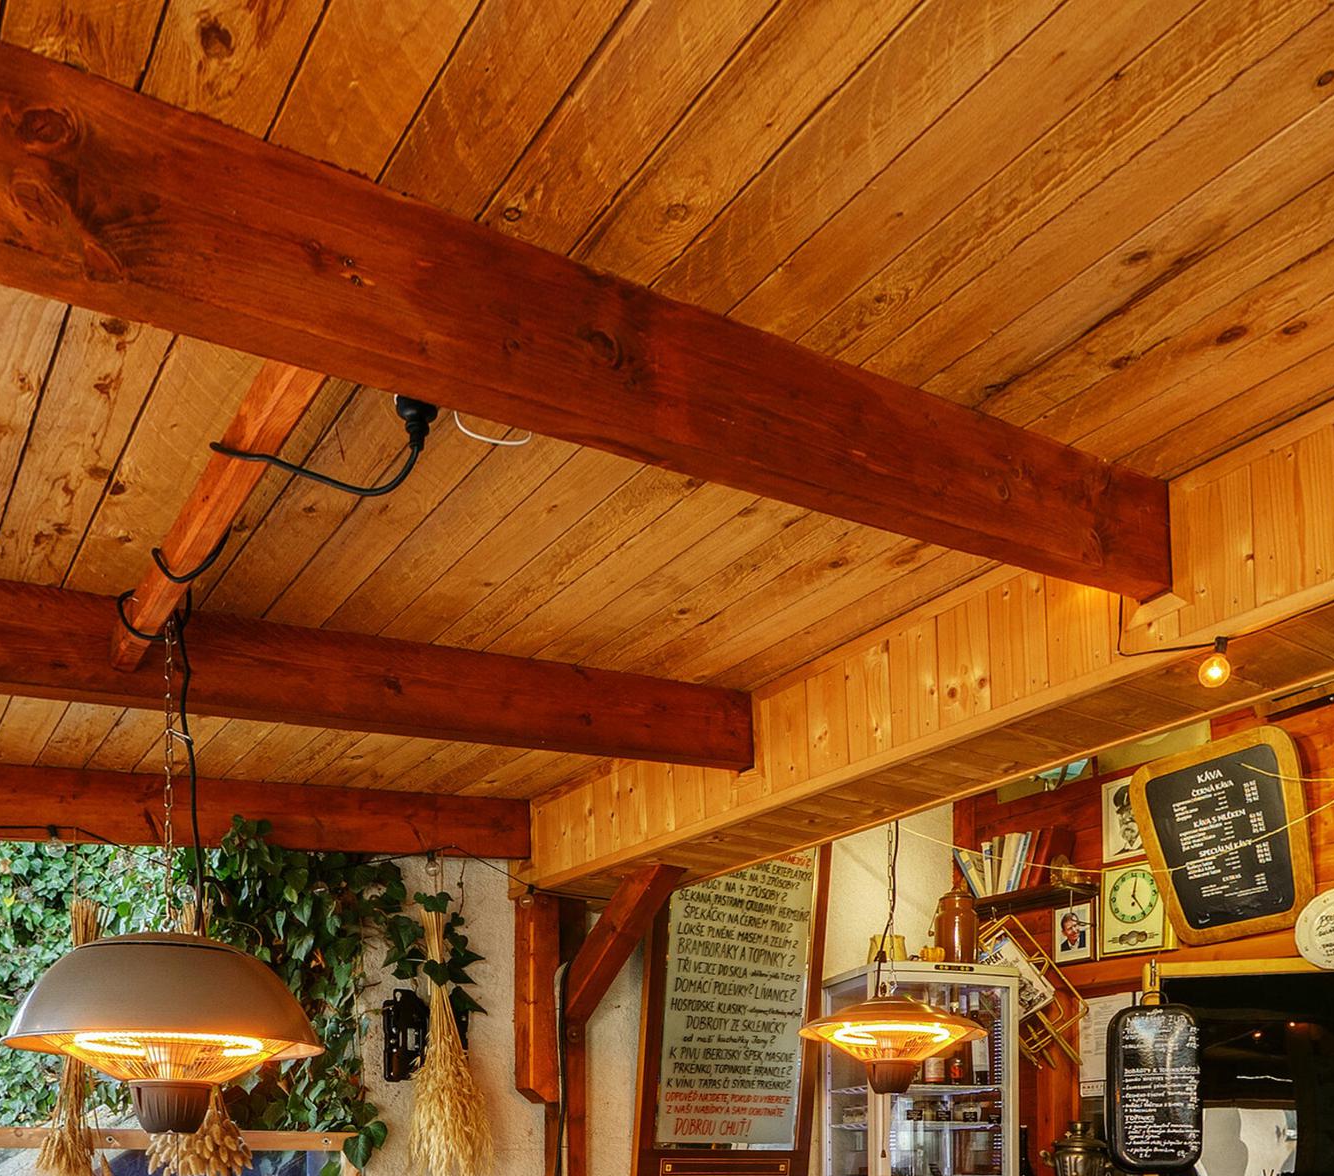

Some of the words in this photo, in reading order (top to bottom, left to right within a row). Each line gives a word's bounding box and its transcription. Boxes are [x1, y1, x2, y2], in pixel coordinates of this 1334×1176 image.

[1196, 769, 1223, 784] KÁVA
[749, 873, 758, 883] NA
[725, 882, 737, 893] NA
[739, 883, 744, 894] 4
[683, 903, 727, 922] ŠPEKÁČKY
[728, 913, 739, 924] NA
[677, 921, 705, 936] LOKŠE
[707, 925, 736, 939] PLNĚNÉ
[737, 930, 763, 944] MASEM
[740, 947, 745, 962] A
[677, 957, 691, 973] TŘI
[693, 961, 717, 976] VEJCE
[718, 964, 728, 976] DO
[728, 965, 748, 979] SKLA
[674, 975, 712, 994] DOMÁCÍ
[717, 1002, 748, 1016] KLASIKY
[685, 1015, 729, 1031] DOBROTY
[730, 1018, 740, 1032] ZE
[741, 1018, 788, 1035] SKLENIČKY
[683, 1034, 693, 1043] od
[669, 1047, 677, 1059] K
[680, 1048, 700, 1060] PIVU
[667, 1078, 673, 1088] K
[675, 1075, 695, 1089] VÍNU
[698, 1078, 722, 1089] TAPAS
[674, 1118, 716, 1136] DOBROU
[720, 1118, 752, 1137] CHUŤ!
